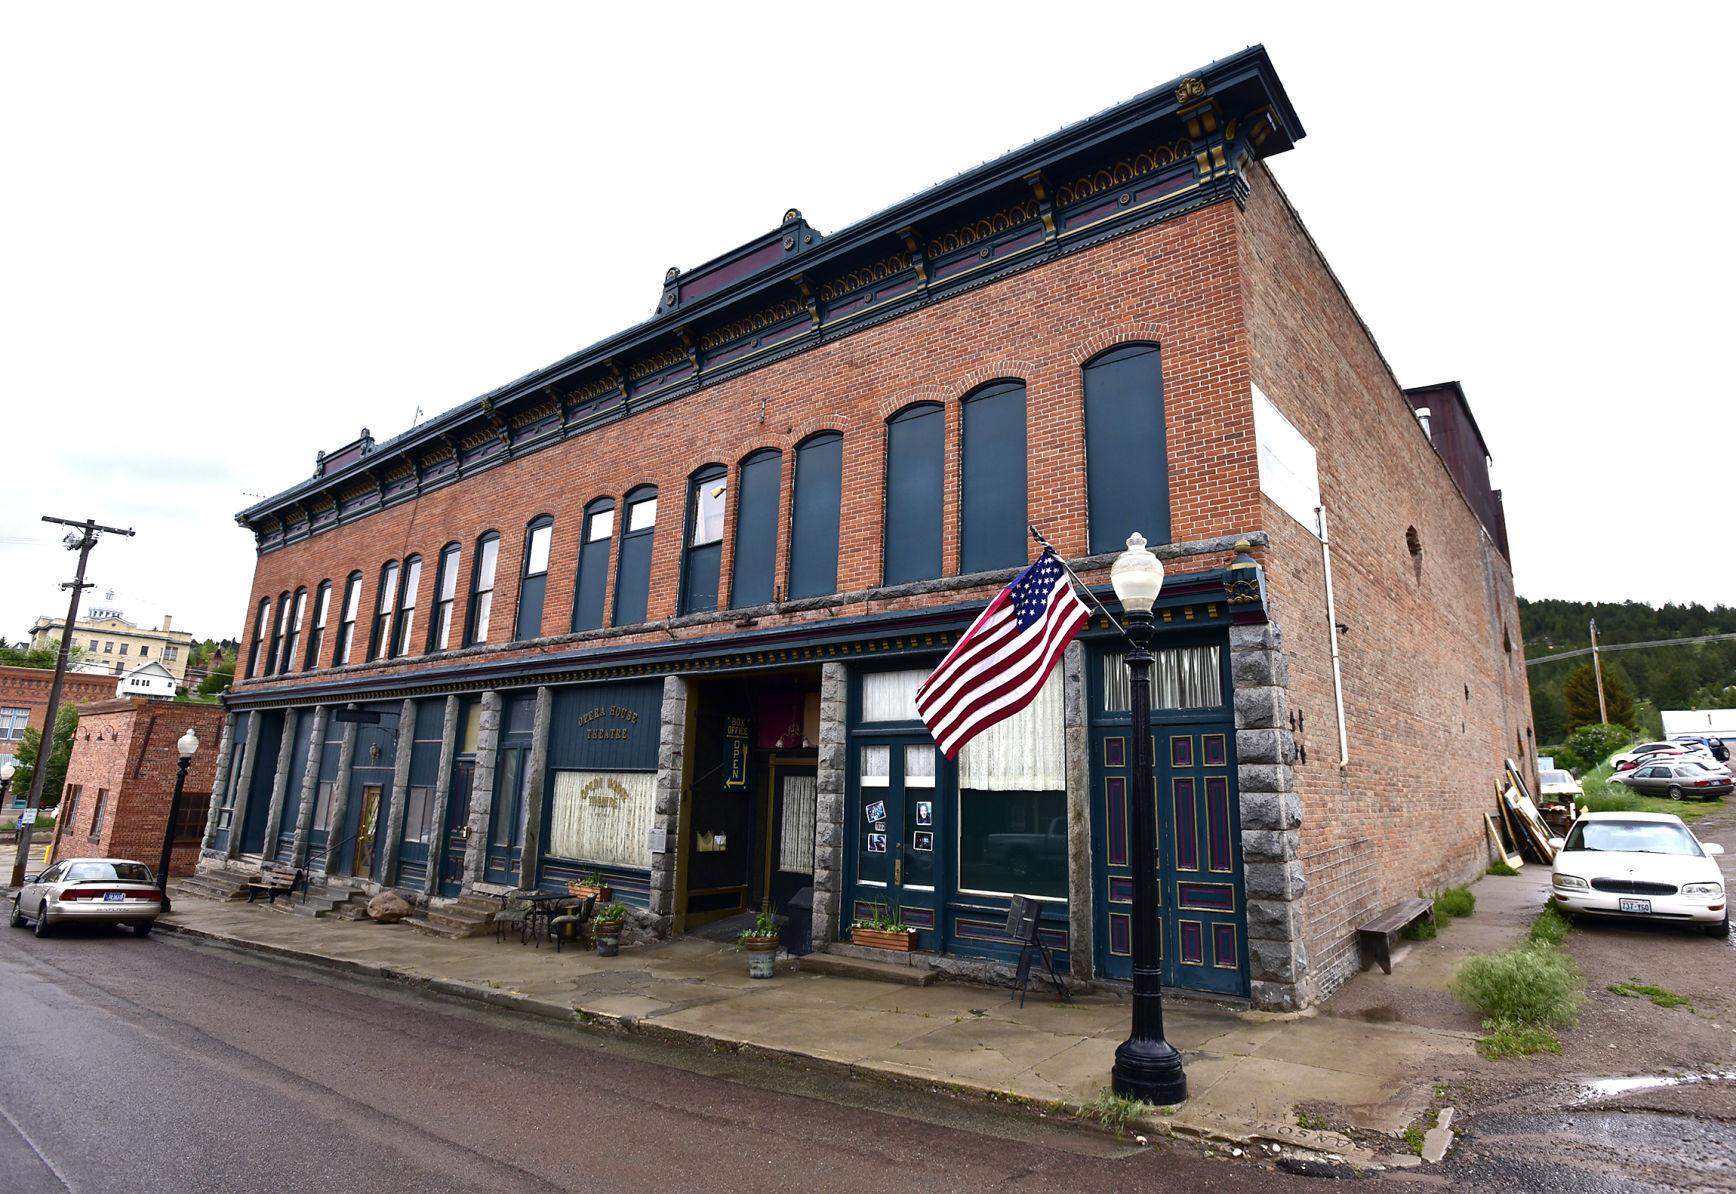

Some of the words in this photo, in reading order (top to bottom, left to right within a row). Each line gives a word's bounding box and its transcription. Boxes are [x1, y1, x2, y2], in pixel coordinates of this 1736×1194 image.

[578, 707, 606, 727] OPERA
[610, 705, 638, 725] HOUSE
[731, 717, 745, 727] BOX
[587, 728, 628, 740] THEATRE
[727, 725, 748, 736] OFFICE
[732, 740, 740, 779] OPEN
